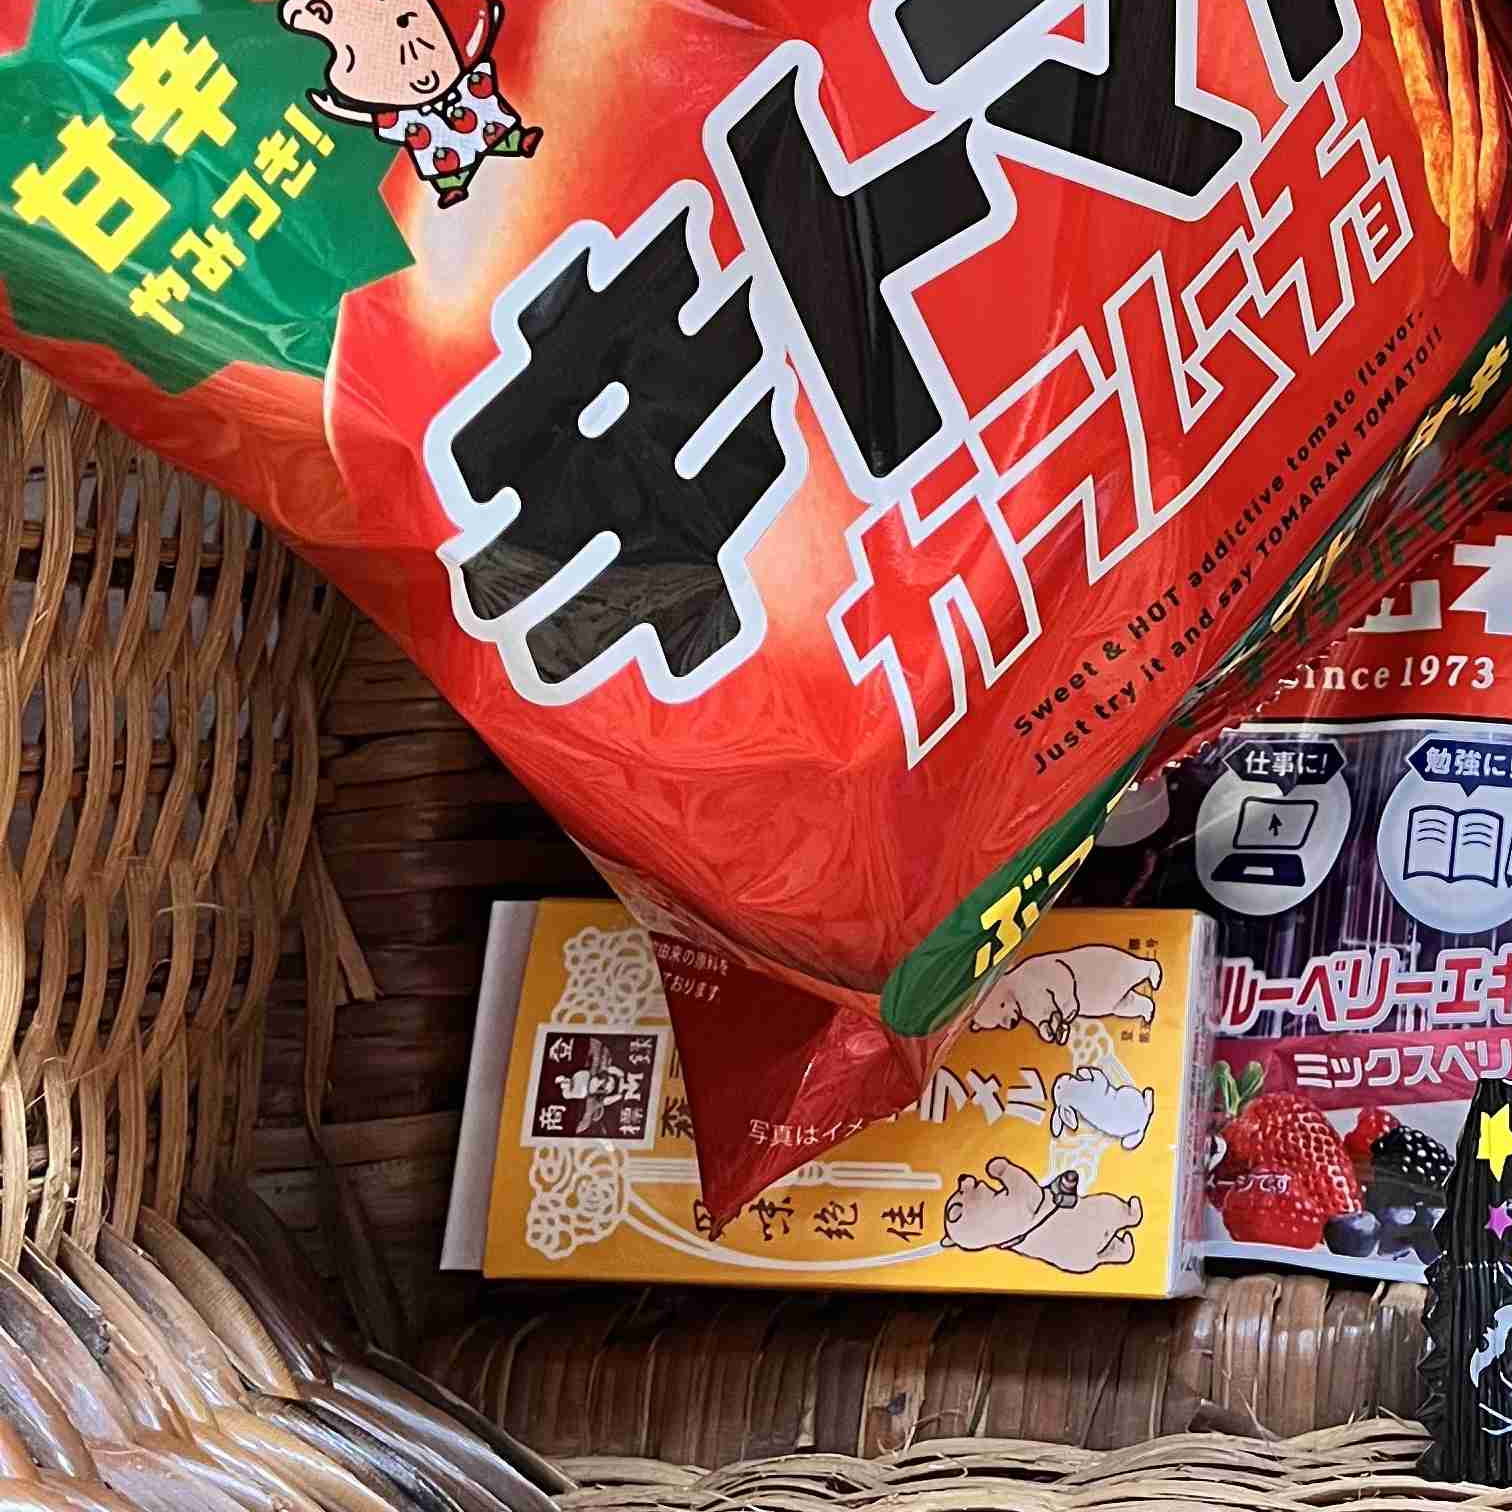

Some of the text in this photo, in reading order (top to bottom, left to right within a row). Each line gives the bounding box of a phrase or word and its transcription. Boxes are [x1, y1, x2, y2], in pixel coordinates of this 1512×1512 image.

[1014, 660, 1100, 737] Sweet
[1103, 639, 1126, 662] &
[1127, 585, 1182, 642] HOT
[1187, 474, 1286, 587] addictive
[1286, 390, 1357, 473] tomato
[1032, 326, 1445, 776] Just try it and say TOMARAN TOMATO!!
[1278, 654, 1496, 692] ince 1973
[1244, 748, 1329, 776] 仕事に!
[919, 1064, 1048, 1126] ラメル
[749, 1117, 865, 1147] 写真はイメ
